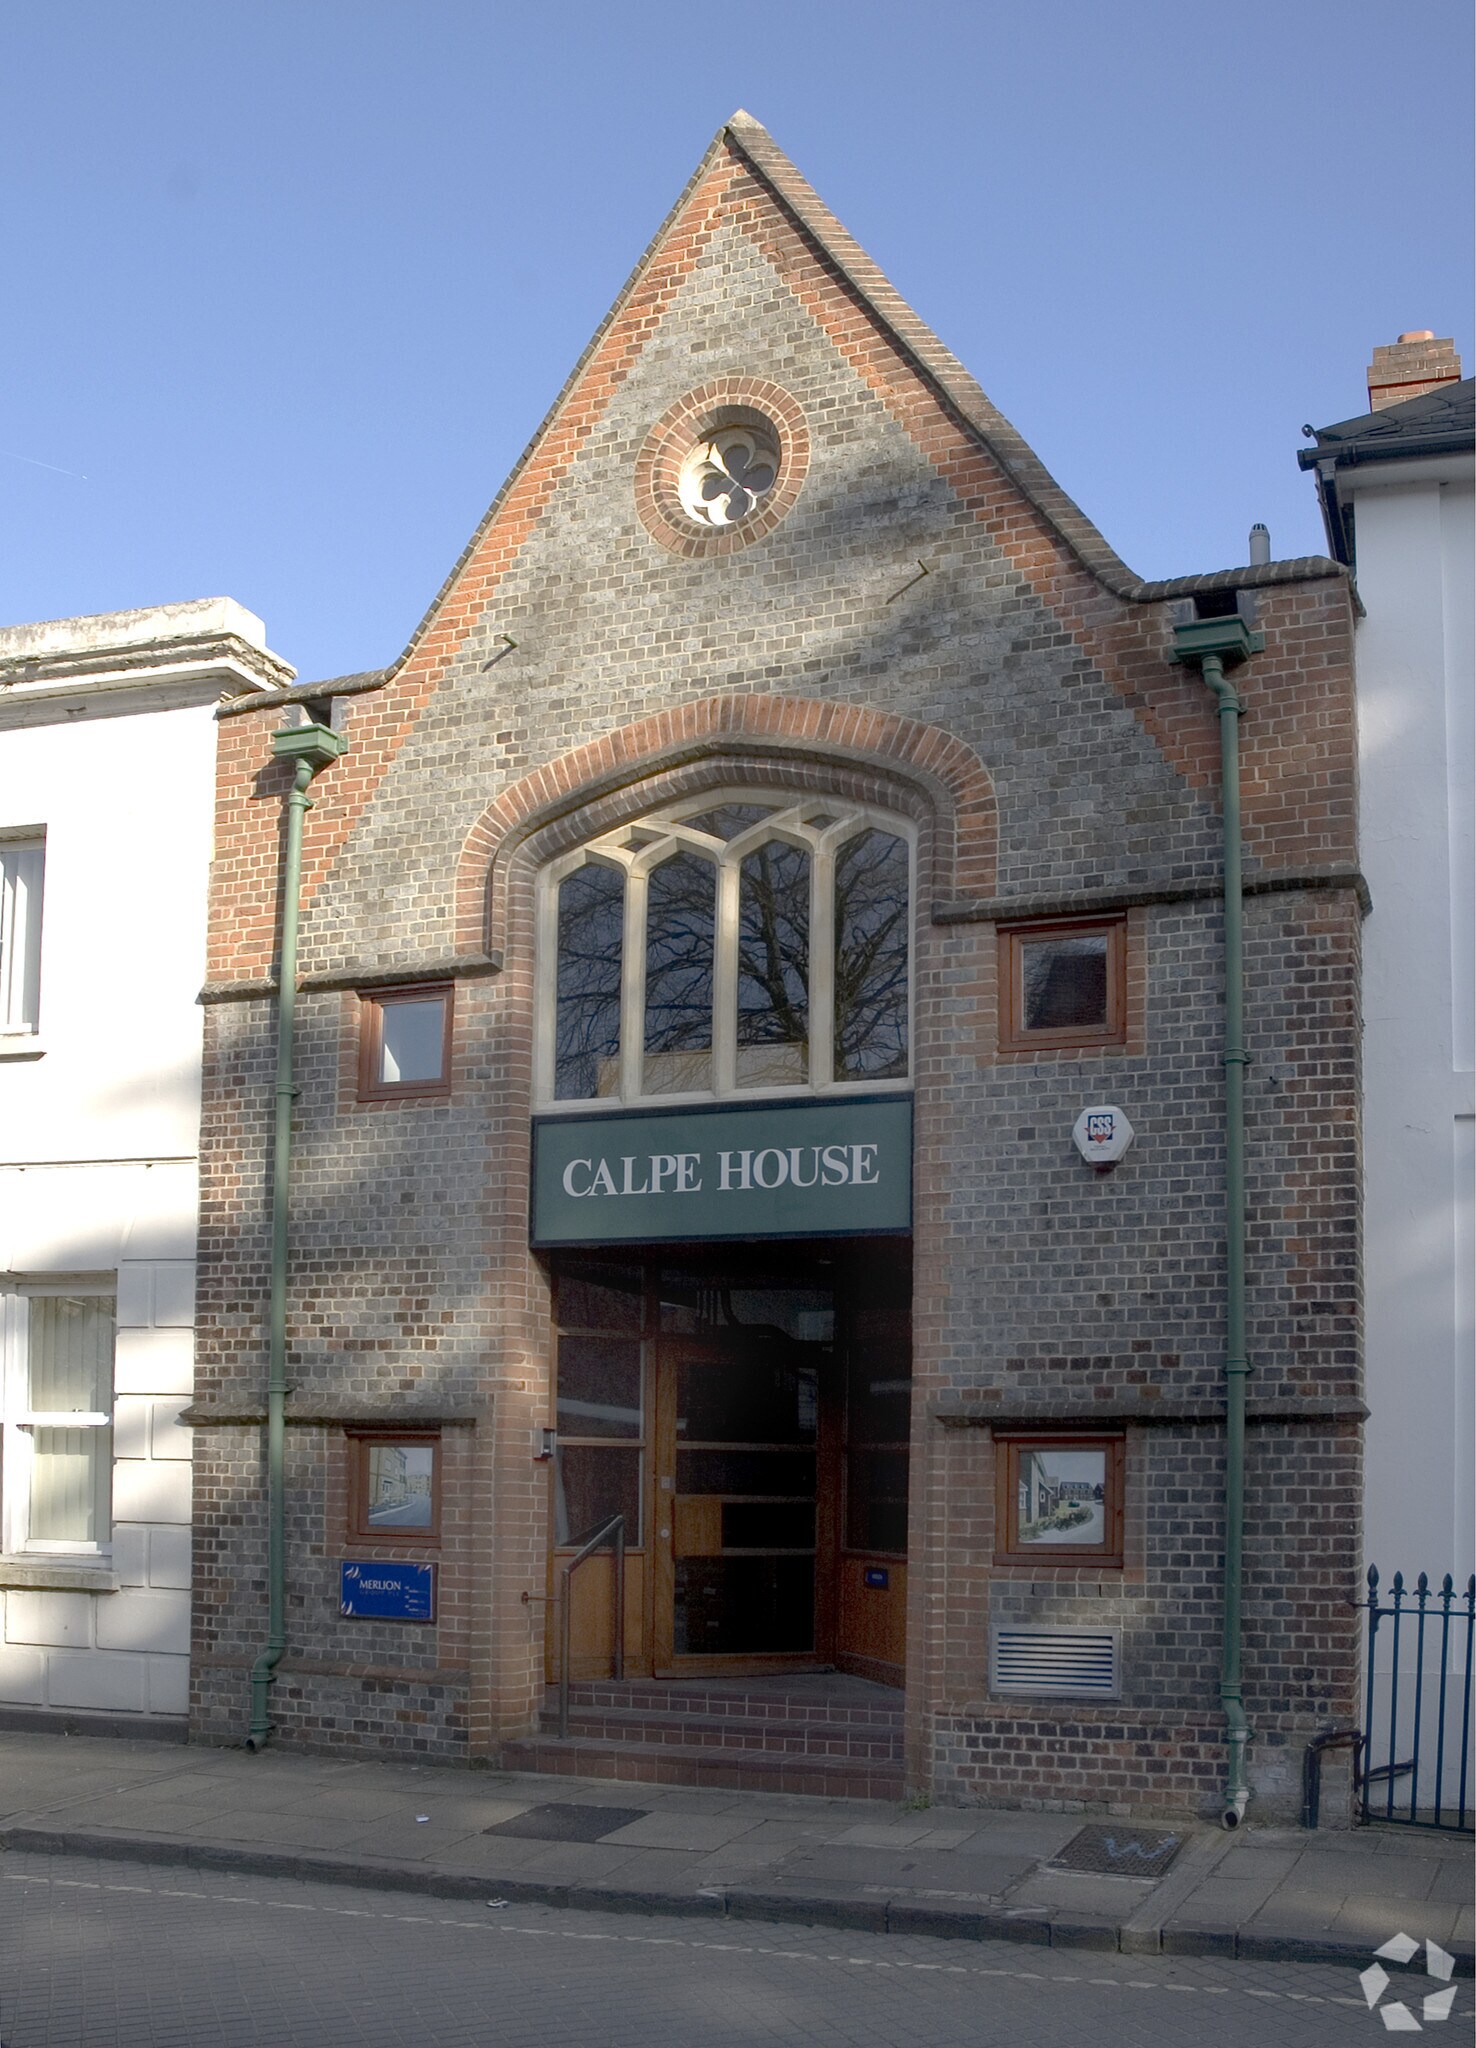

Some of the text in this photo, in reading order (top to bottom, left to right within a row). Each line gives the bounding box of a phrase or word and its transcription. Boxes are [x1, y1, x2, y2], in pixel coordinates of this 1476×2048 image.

[1090, 1116, 1112, 1135] CSS
[562, 1144, 880, 1198] CALPE HOUSE
[359, 1580, 401, 1590] MERLION
